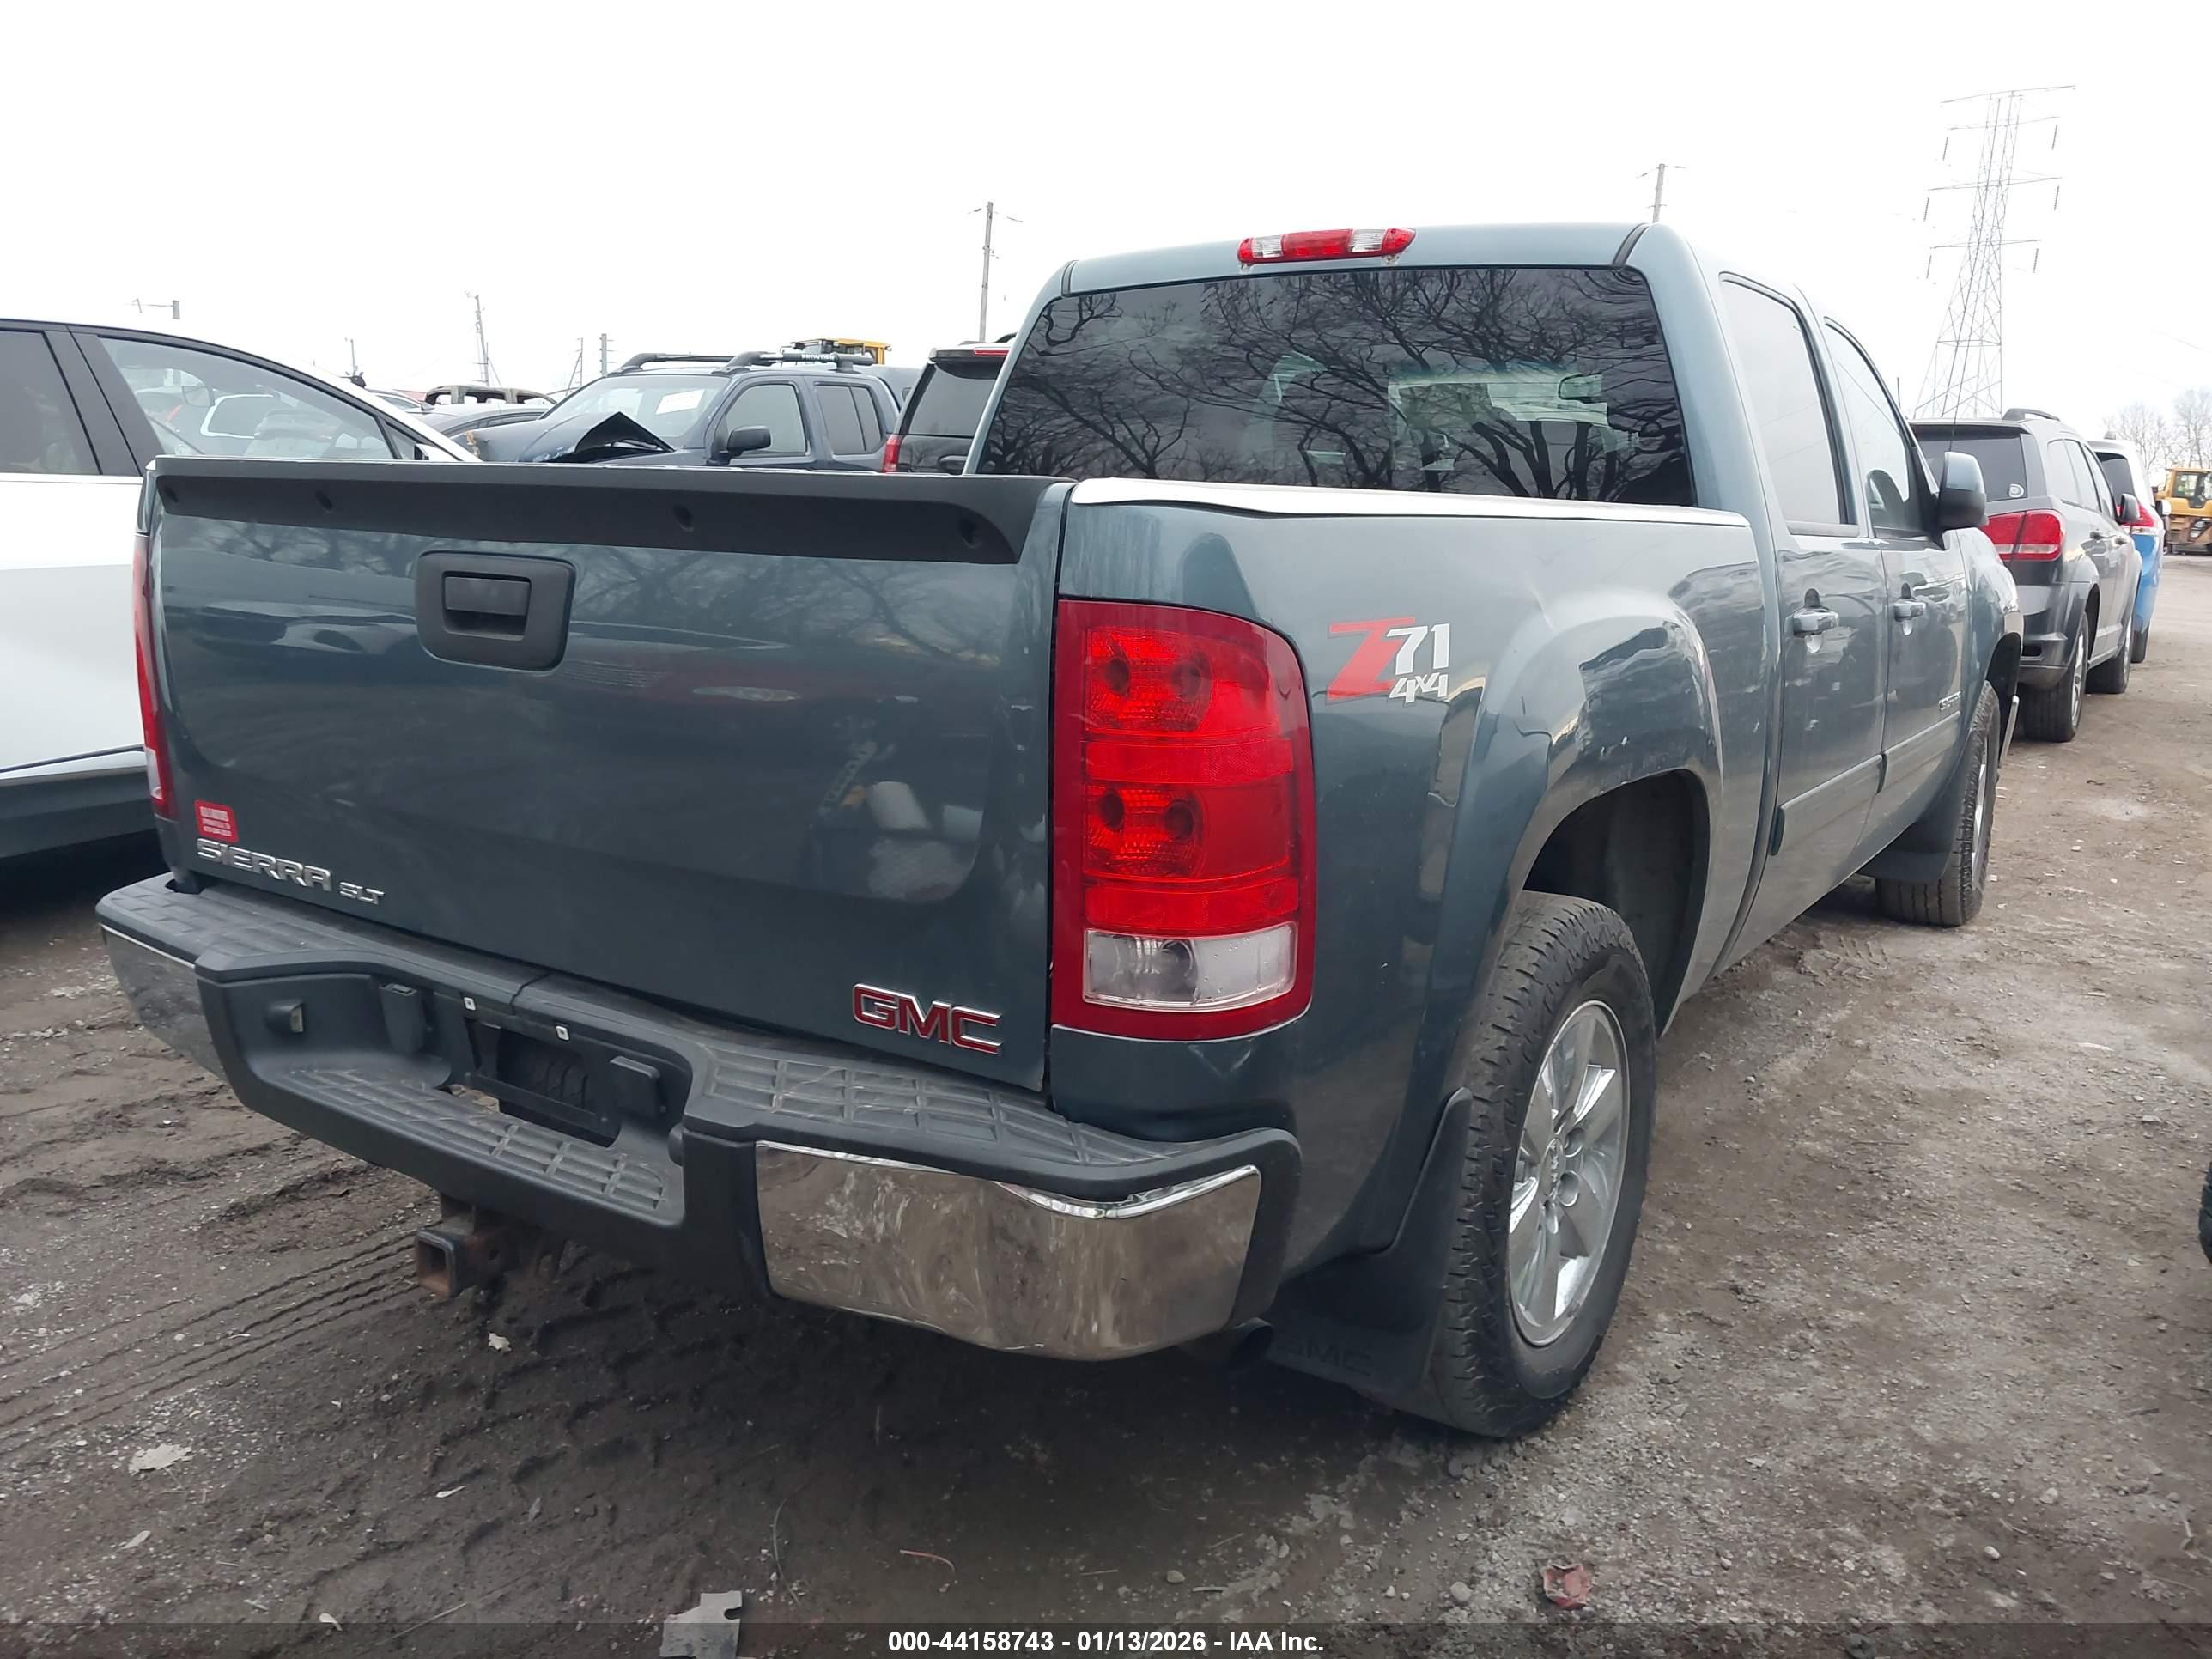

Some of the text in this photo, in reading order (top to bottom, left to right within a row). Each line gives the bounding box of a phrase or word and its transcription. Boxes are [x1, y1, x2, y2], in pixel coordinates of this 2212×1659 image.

[1328, 617, 1449, 701] Z71
[198, 839, 385, 905] SIERRA SLT
[853, 983, 1003, 1054] GMC
